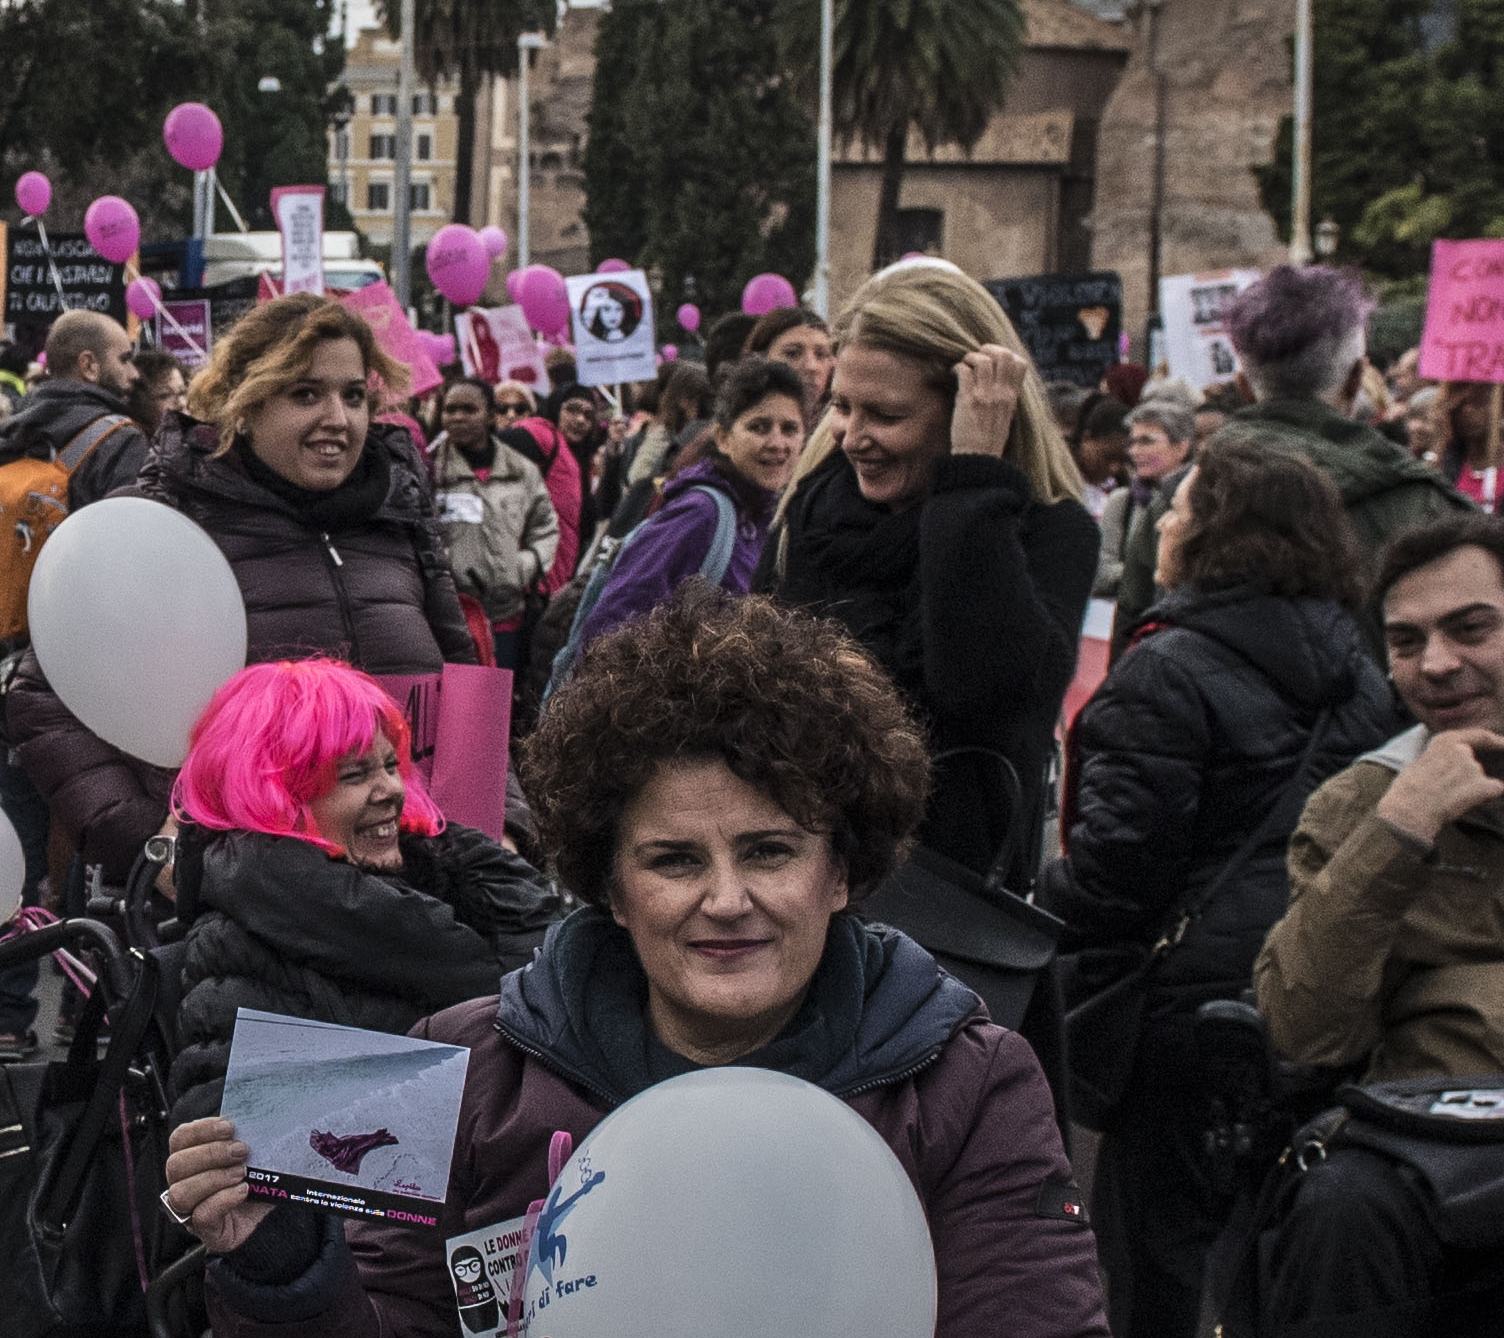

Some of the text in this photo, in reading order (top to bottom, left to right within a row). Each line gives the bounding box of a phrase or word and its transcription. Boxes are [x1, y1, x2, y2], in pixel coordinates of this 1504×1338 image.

[248, 1170, 280, 1183] 2017
[248, 1184, 288, 1200] NATA
[386, 1209, 437, 1227] DONNE
[484, 1238, 496, 1256] LE
[539, 1287, 550, 1311] di
[556, 1274, 598, 1300] fare
